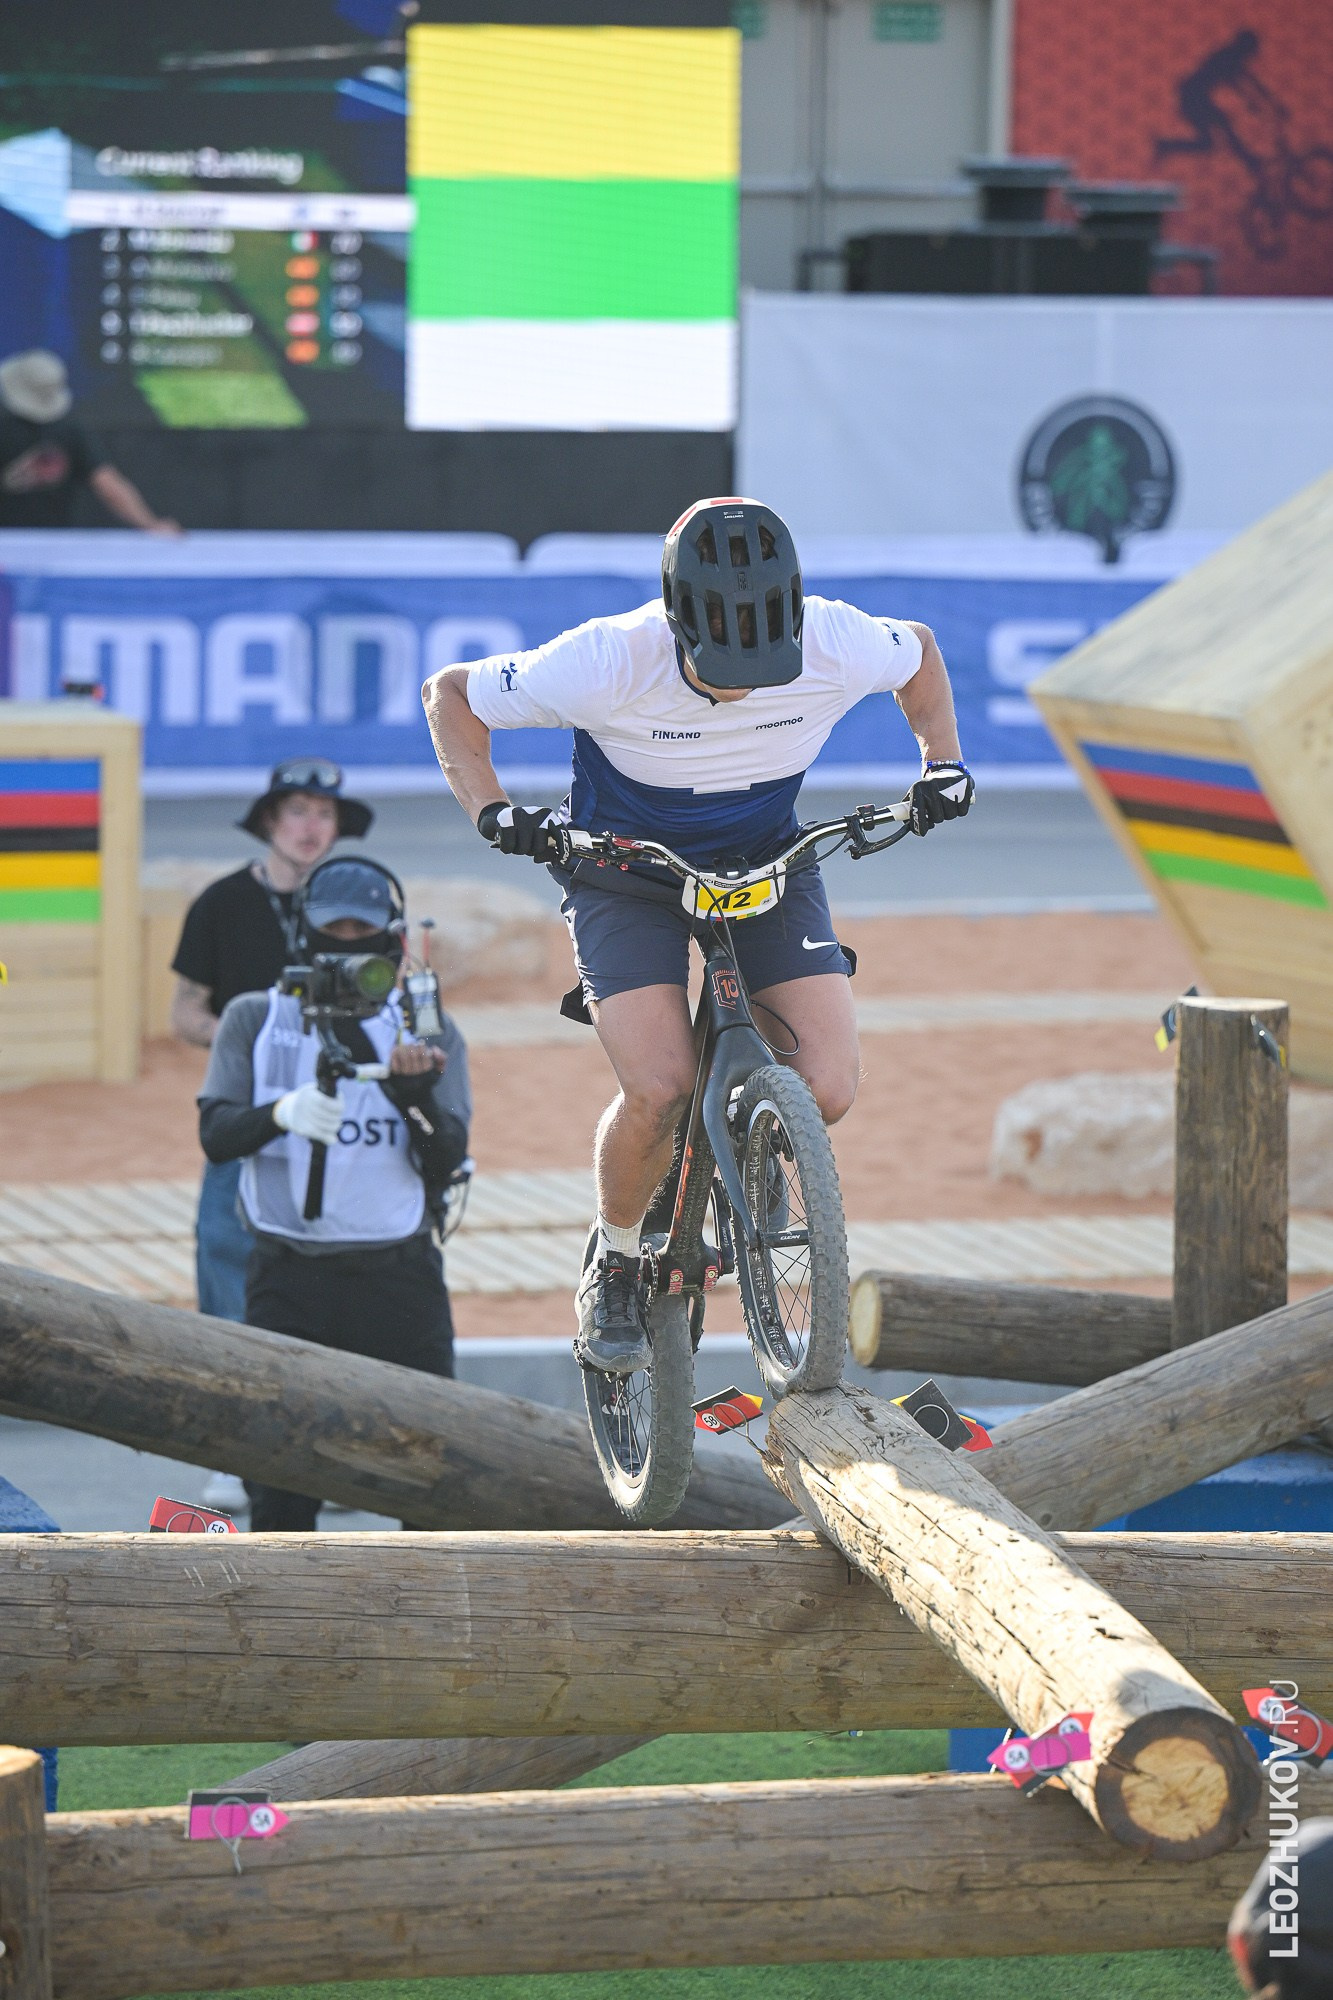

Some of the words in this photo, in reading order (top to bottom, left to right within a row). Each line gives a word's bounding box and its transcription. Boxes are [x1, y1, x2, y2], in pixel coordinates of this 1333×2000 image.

[755, 716, 804, 731] moomoo
[652, 730, 701, 740] FINLAND
[716, 891, 752, 909] 12
[720, 978, 739, 998] 10
